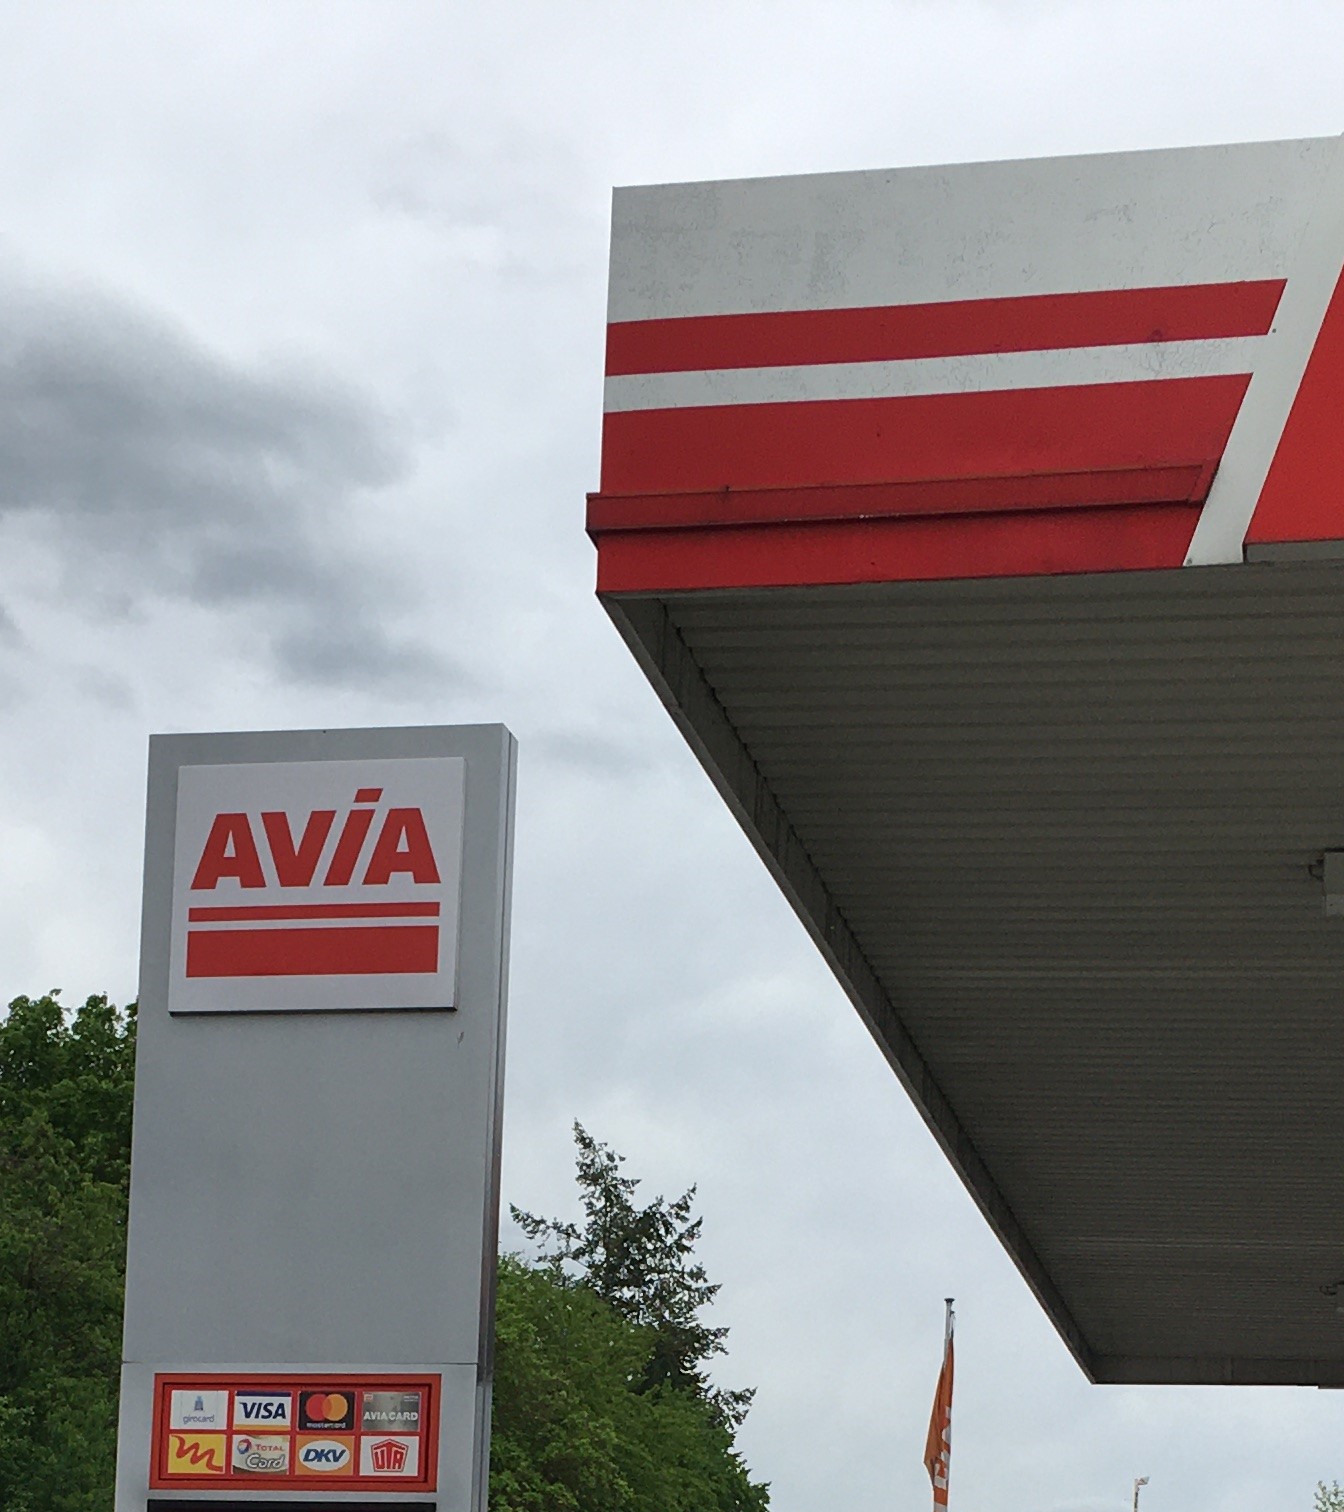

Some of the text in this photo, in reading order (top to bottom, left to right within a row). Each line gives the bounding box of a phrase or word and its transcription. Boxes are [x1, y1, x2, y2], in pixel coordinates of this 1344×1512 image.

[190, 788, 441, 890] AVIA
[239, 1402, 286, 1419] VISA
[183, 1414, 215, 1425] girocard
[245, 1452, 286, 1469] Card
[302, 1448, 346, 1462] DKV
[373, 1441, 406, 1469] UTA
